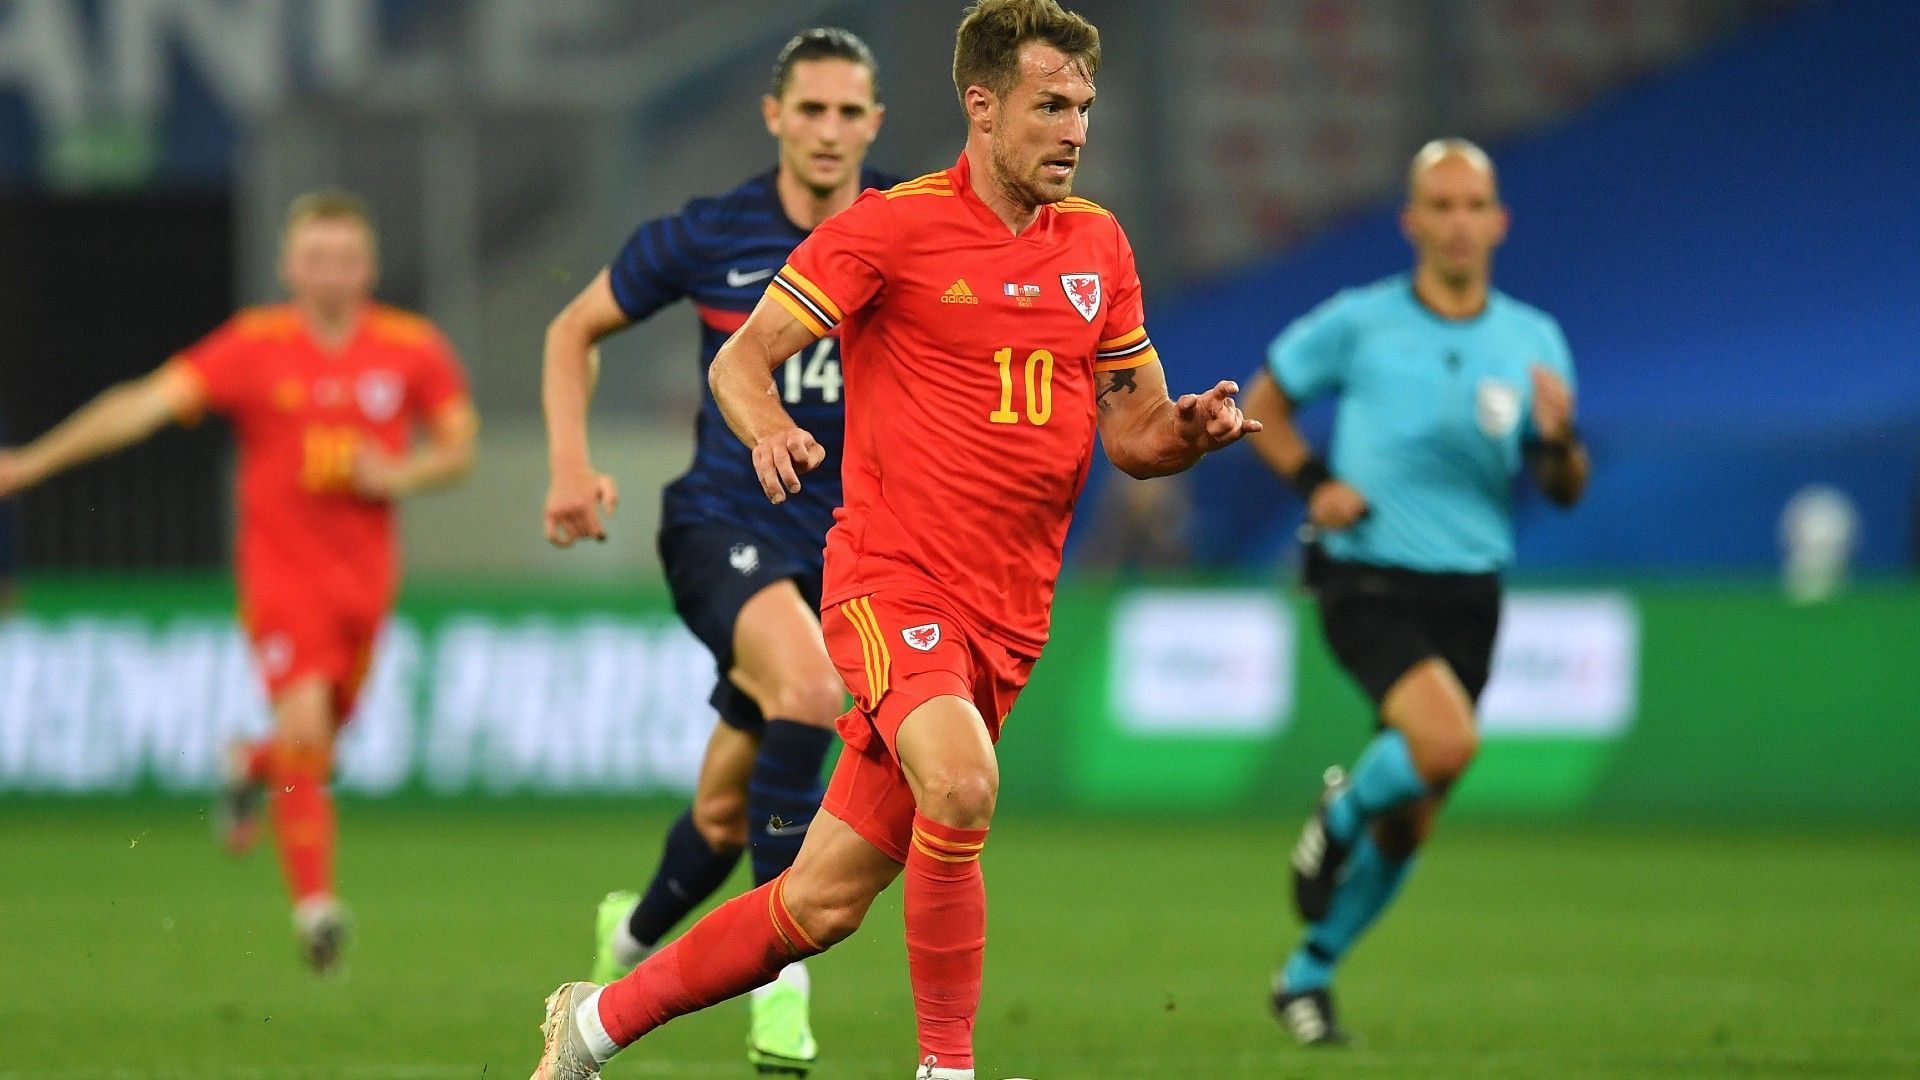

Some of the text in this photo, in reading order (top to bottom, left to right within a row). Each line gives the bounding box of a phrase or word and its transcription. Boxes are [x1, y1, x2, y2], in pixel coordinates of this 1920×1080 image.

[941, 294, 979, 305] adidas
[784, 337, 844, 404] 14
[989, 347, 1054, 426] 10
